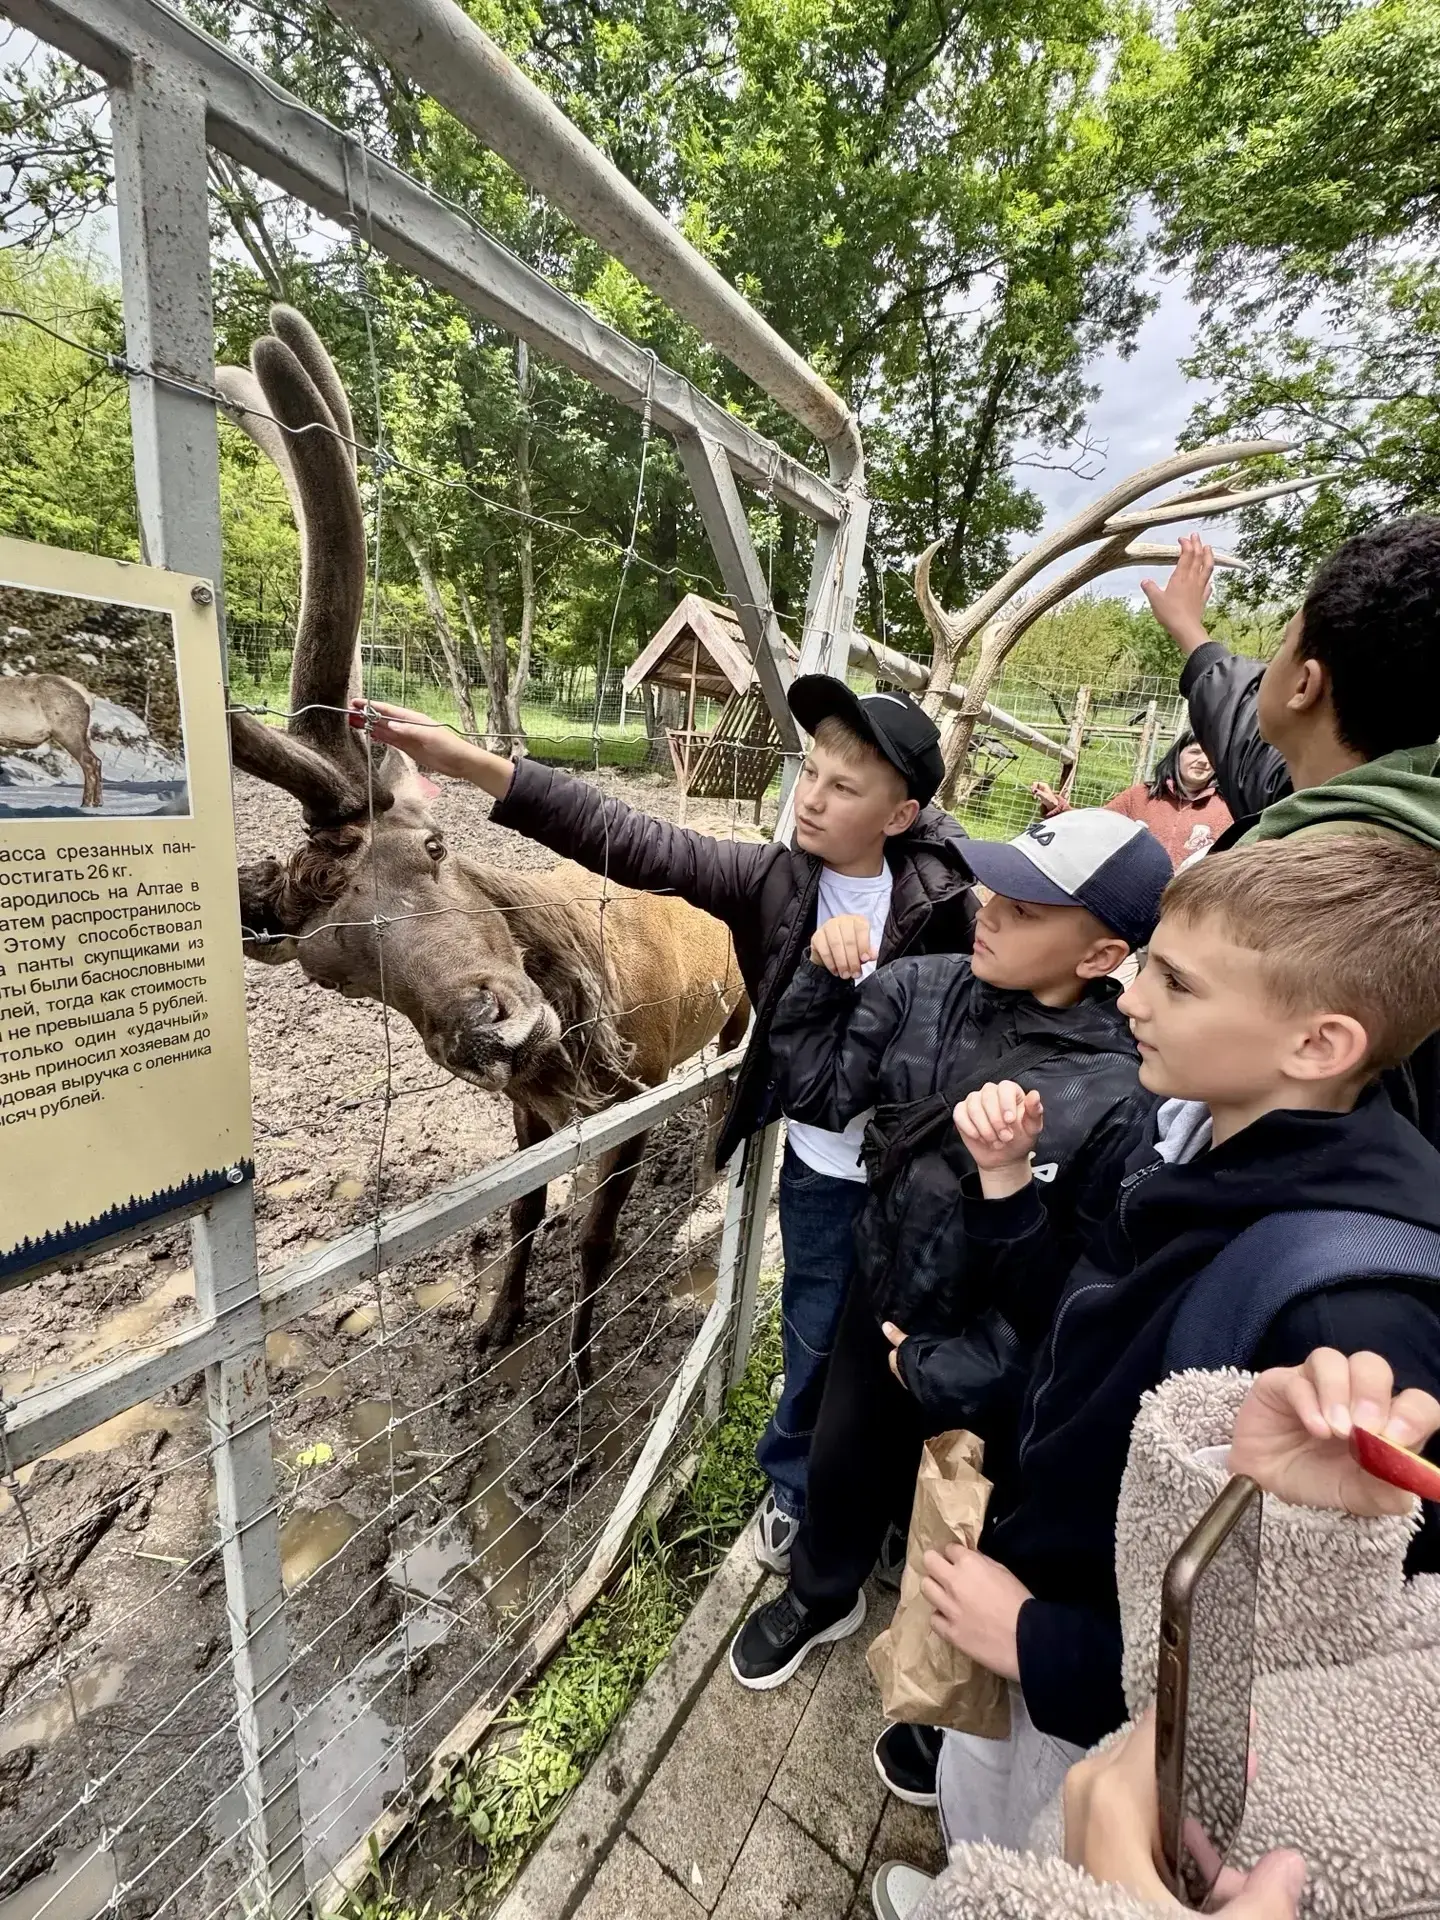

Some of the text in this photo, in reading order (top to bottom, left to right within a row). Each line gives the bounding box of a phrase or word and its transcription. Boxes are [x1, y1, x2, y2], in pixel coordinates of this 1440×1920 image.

[56, 844, 154, 862] срезанных
[163, 842, 196, 854] пан-
[87, 864, 109, 879] 26
[112, 866, 132, 878] кг.
[108, 887, 128, 899] на
[136, 882, 183, 897] Алтае
[191, 882, 199, 892] в
[51, 901, 201, 930] распространилось
[4, 920, 202, 953] Этому способствовал
[18, 956, 74, 974] панты
[84, 942, 180, 966] скупщиками
[188, 938, 204, 950] из
[0, 957, 205, 999] ты были баснословными
[46, 994, 94, 1012] тогда
[100, 989, 126, 1003] как
[131, 976, 207, 997] стоимость
[8, 1027, 31, 1040] не
[36, 1007, 135, 1036] превышала
[139, 1001, 148, 1015] 5
[152, 991, 207, 1016] рублей.
[75, 1030, 116, 1048] один
[127, 1010, 208, 1038] «удачный»
[35, 1049, 116, 1078] приносил
[120, 1033, 190, 1057] хозяевам
[193, 1028, 210, 1042] до
[61, 1065, 129, 1090] выручка
[133, 1062, 142, 1072] с
[146, 1045, 212, 1069] оленника
[40, 1088, 105, 1119] рублей.
